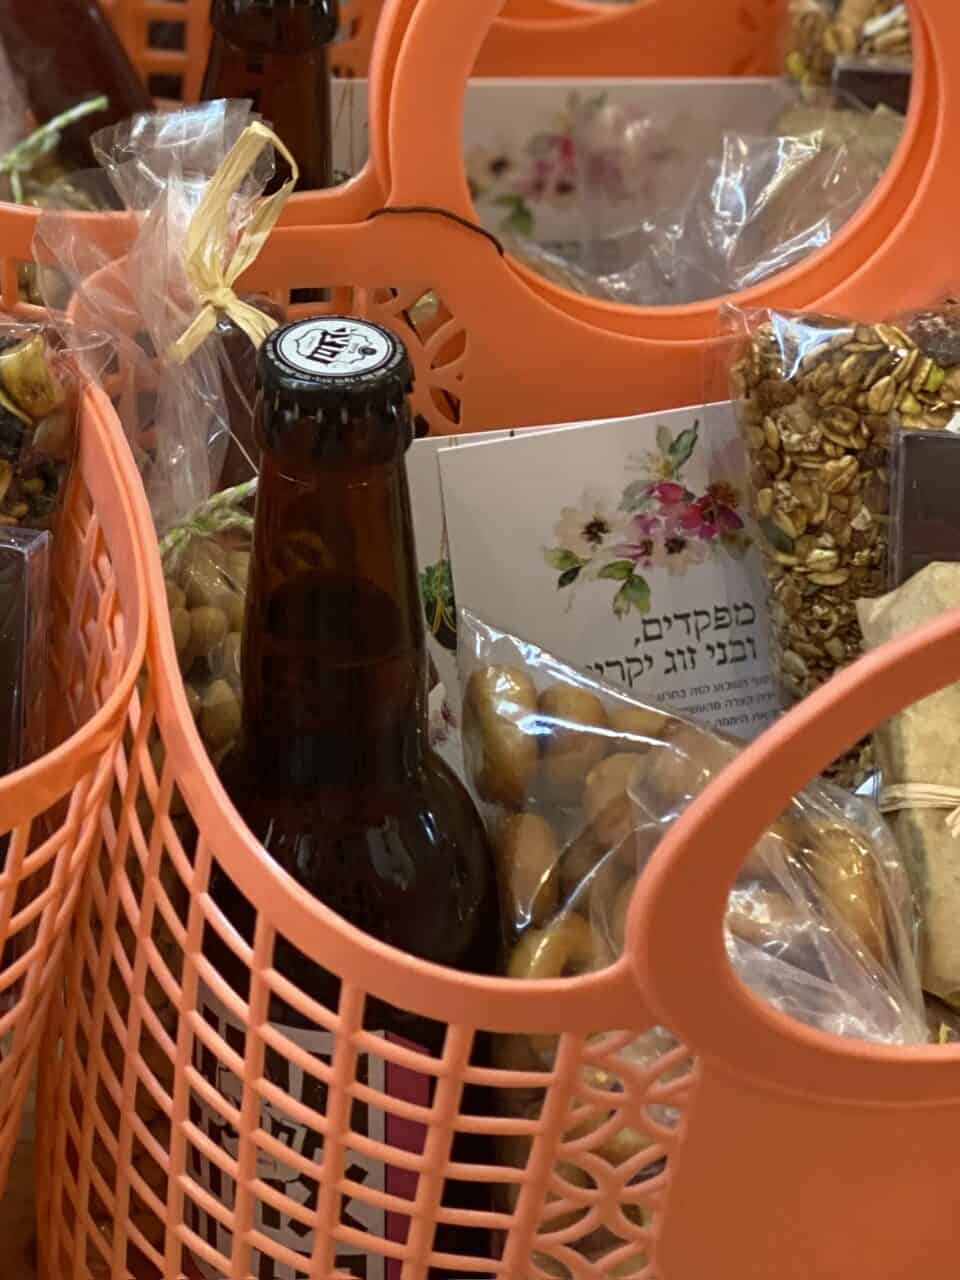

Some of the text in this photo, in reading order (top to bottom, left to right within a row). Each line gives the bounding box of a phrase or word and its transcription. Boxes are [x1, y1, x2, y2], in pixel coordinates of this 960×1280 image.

[634, 601, 757, 649] מפקדים,
[586, 637, 758, 688] ובני זוג יקרי
